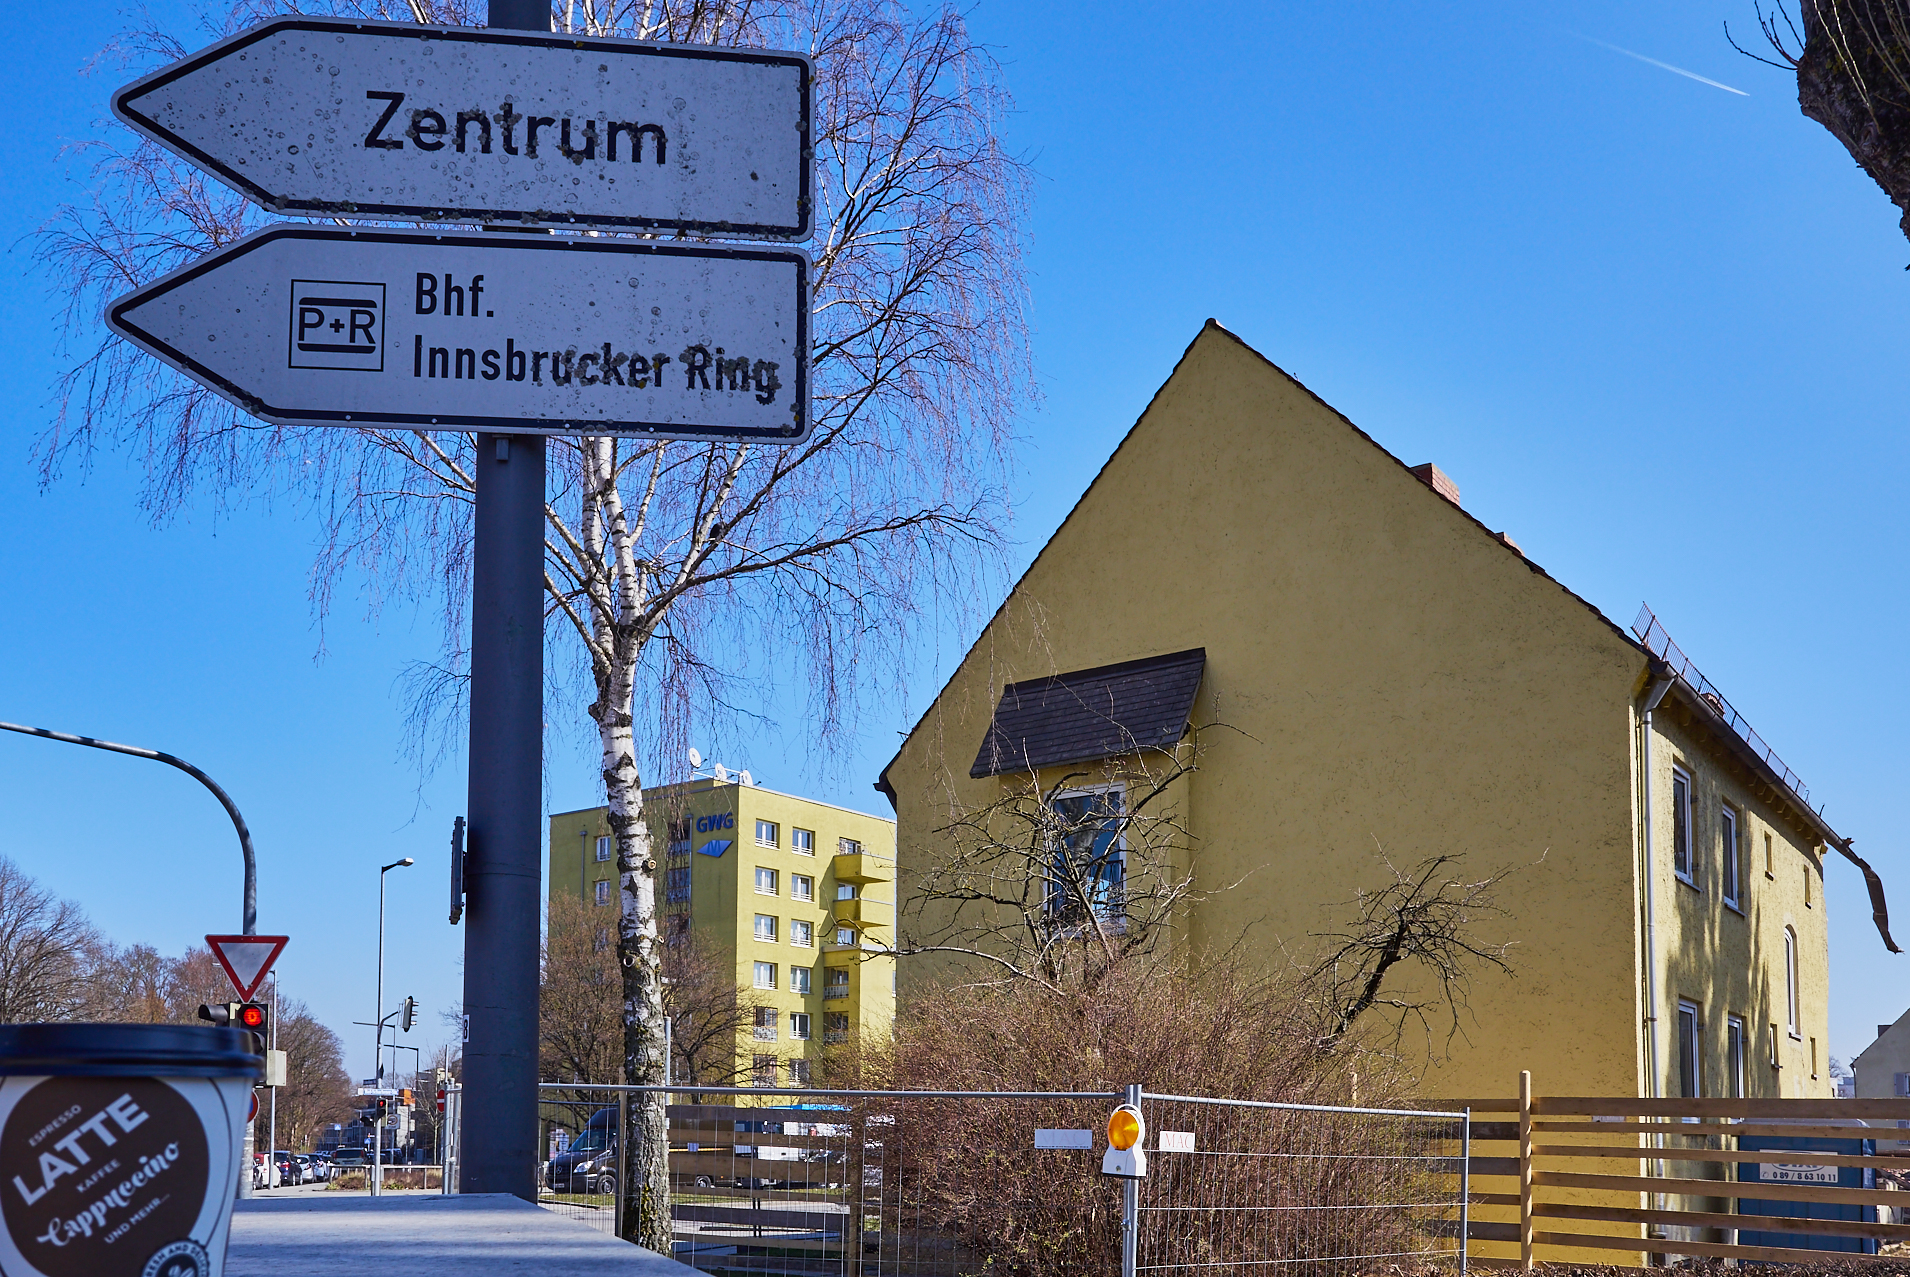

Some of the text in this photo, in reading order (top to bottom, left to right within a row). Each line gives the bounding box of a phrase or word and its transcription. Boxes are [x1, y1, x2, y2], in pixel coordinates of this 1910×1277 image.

[364, 90, 667, 165] Zentrum
[415, 272, 494, 318] Bhf.
[298, 306, 377, 345] P+R
[413, 334, 782, 405] Innsbrucker Ring
[696, 812, 733, 833] GWG
[28, 1104, 82, 1148] ESPRESSO
[1040, 1130, 1087, 1146] MAC
[1164, 1132, 1194, 1149] MAC
[12, 1092, 150, 1207] LATTE
[36, 1141, 180, 1247] Cappuccino
[76, 1158, 121, 1194] KAFFEE
[1772, 1171, 1778, 1179] 0
[1780, 1171, 1789, 1179] 89
[1797, 1172, 1803, 1180] 8
[1804, 1172, 1814, 1180] 63
[1816, 1173, 1826, 1181] 10
[1828, 1174, 1837, 1182] 11
[104, 1222, 131, 1244] UND
